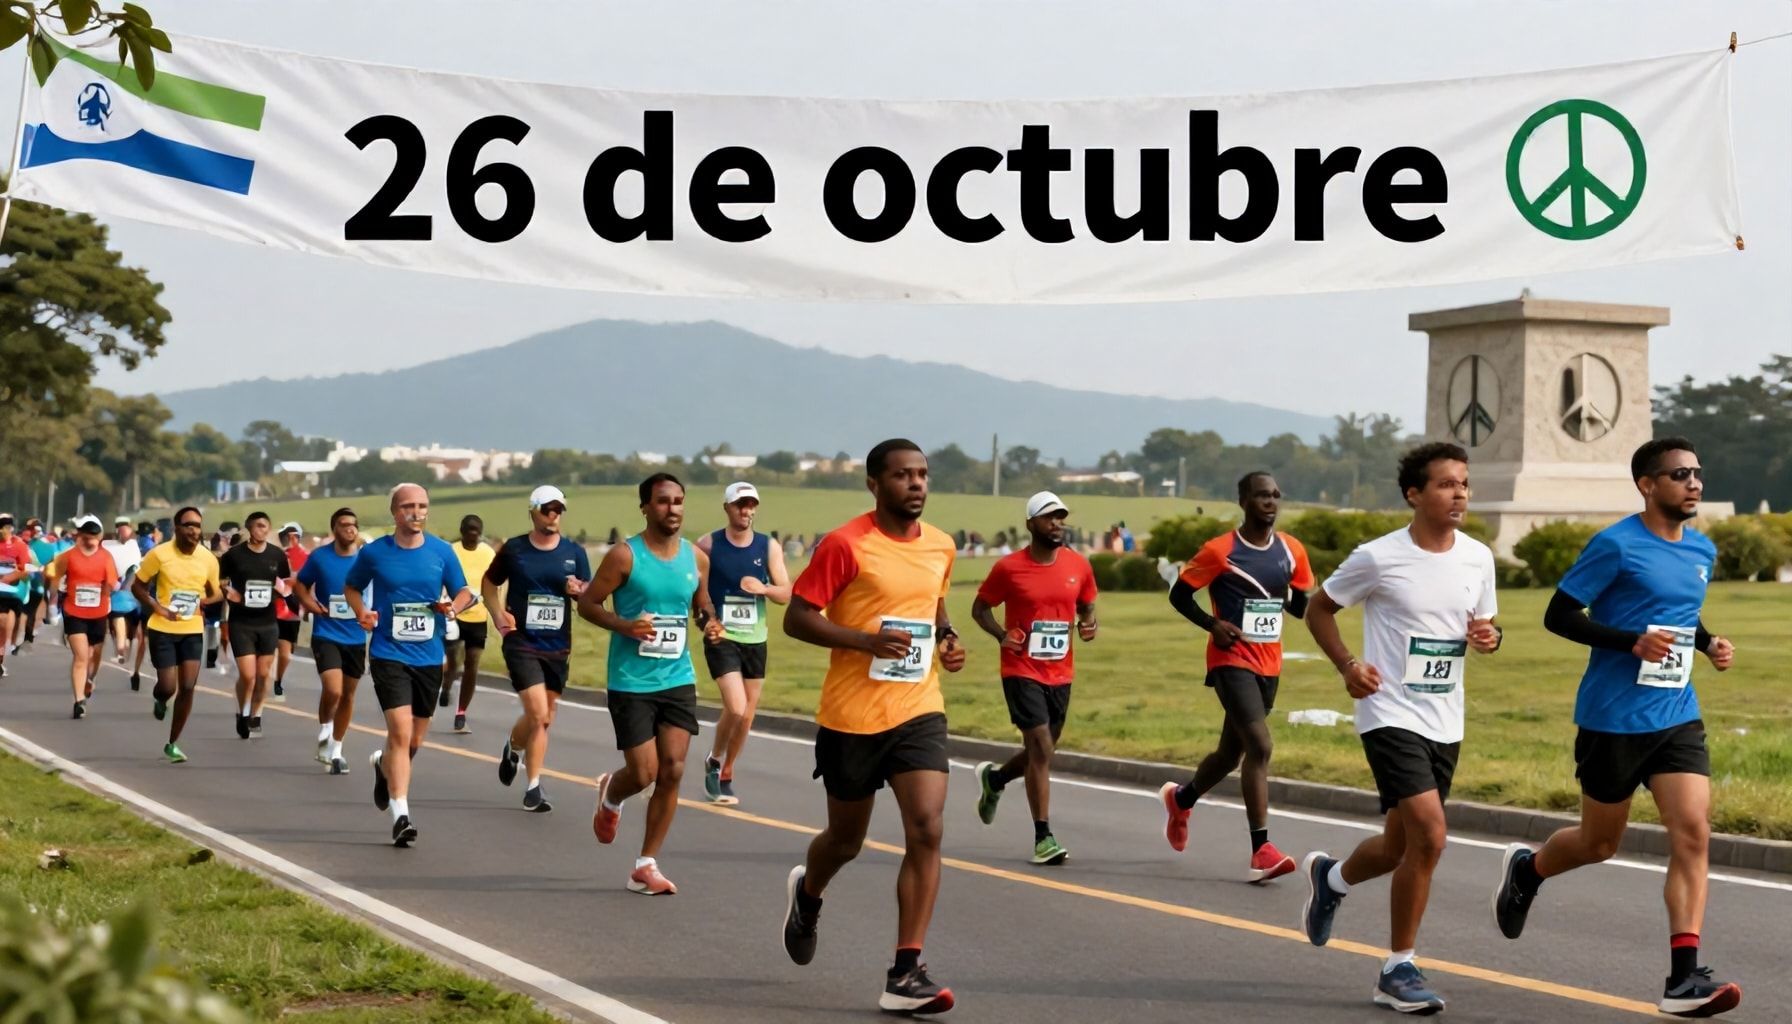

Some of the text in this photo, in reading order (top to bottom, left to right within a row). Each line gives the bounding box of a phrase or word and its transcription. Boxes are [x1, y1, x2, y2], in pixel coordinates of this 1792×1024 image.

[345, 110, 1447, 243] 26 de octubre
